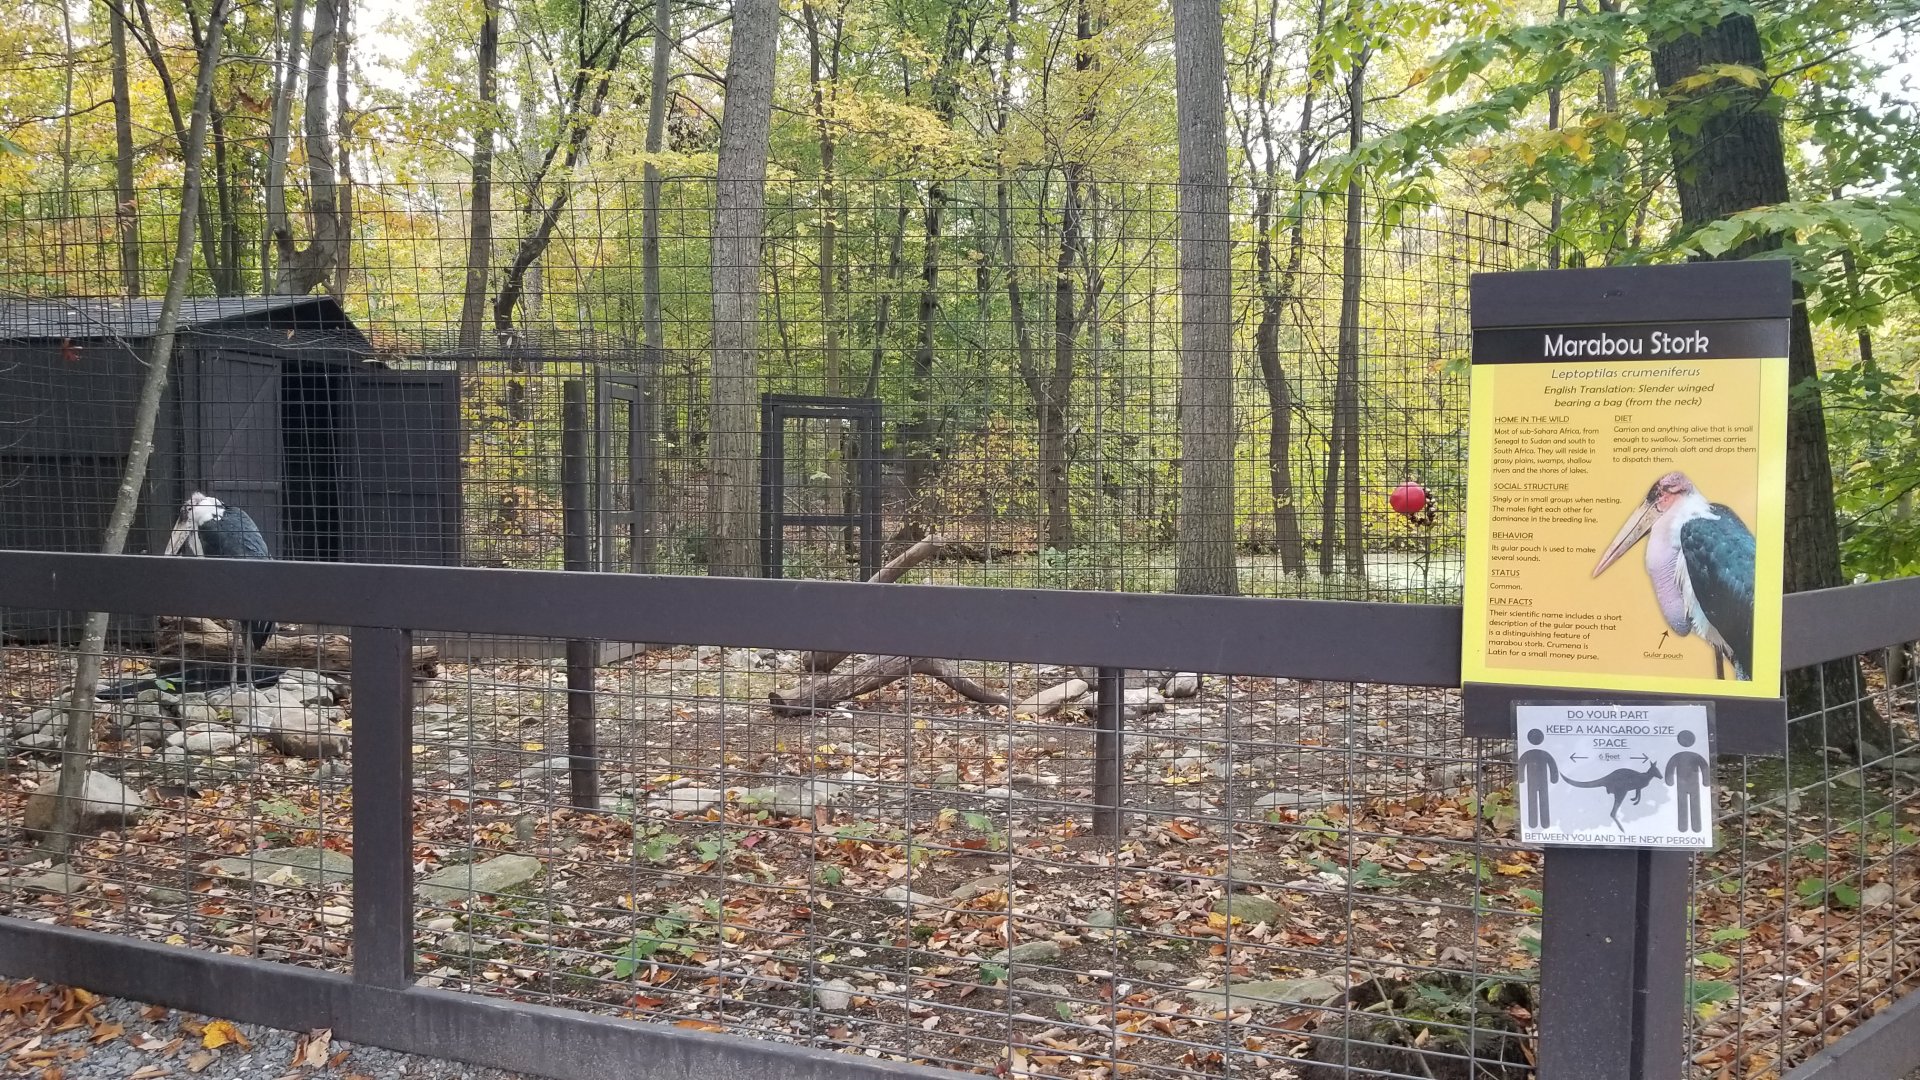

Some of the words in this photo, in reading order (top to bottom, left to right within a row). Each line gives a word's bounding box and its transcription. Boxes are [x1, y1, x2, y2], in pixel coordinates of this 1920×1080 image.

[1544, 333, 1643, 356] Marabou
[1651, 330, 1709, 354] Stork
[1552, 368, 1618, 380] Leptoptilas
[1622, 367, 1700, 377] crumeniferus
[1544, 386, 1577, 395] English
[1580, 385, 1636, 393] Translation:
[1638, 384, 1675, 393] Slender
[1678, 384, 1714, 393] winged
[1555, 398, 1591, 407] bearing
[1604, 398, 1622, 408] bag
[1625, 398, 1652, 407] (from
[1655, 398, 1670, 406] the
[1674, 397, 1702, 406] neck)
[1715, 446, 1735, 454] drops
[1565, 612, 1594, 620] includes
[1489, 620, 1527, 628] description
[1553, 622, 1573, 630] gular
[1575, 622, 1598, 631] pouch
[1502, 630, 1551, 639] distinguishing
[1547, 641, 1581, 649] Crumena
[1577, 653, 1599, 661] purse.
[1586, 711, 1617, 719] YOUR
[1620, 711, 1648, 719] PART
[1546, 725, 1573, 733] KEEP
[1587, 726, 1650, 734] KANGAROO
[1653, 726, 1674, 735] SIZE
[1593, 739, 1627, 747] SPACE
[1525, 833, 1569, 841] BETWEEN
[1572, 834, 1591, 842] YOU
[1595, 834, 1615, 843] AND
[1619, 835, 1636, 843] THE
[1640, 836, 1663, 844] NEXT
[1667, 837, 1705, 845] PERSON
